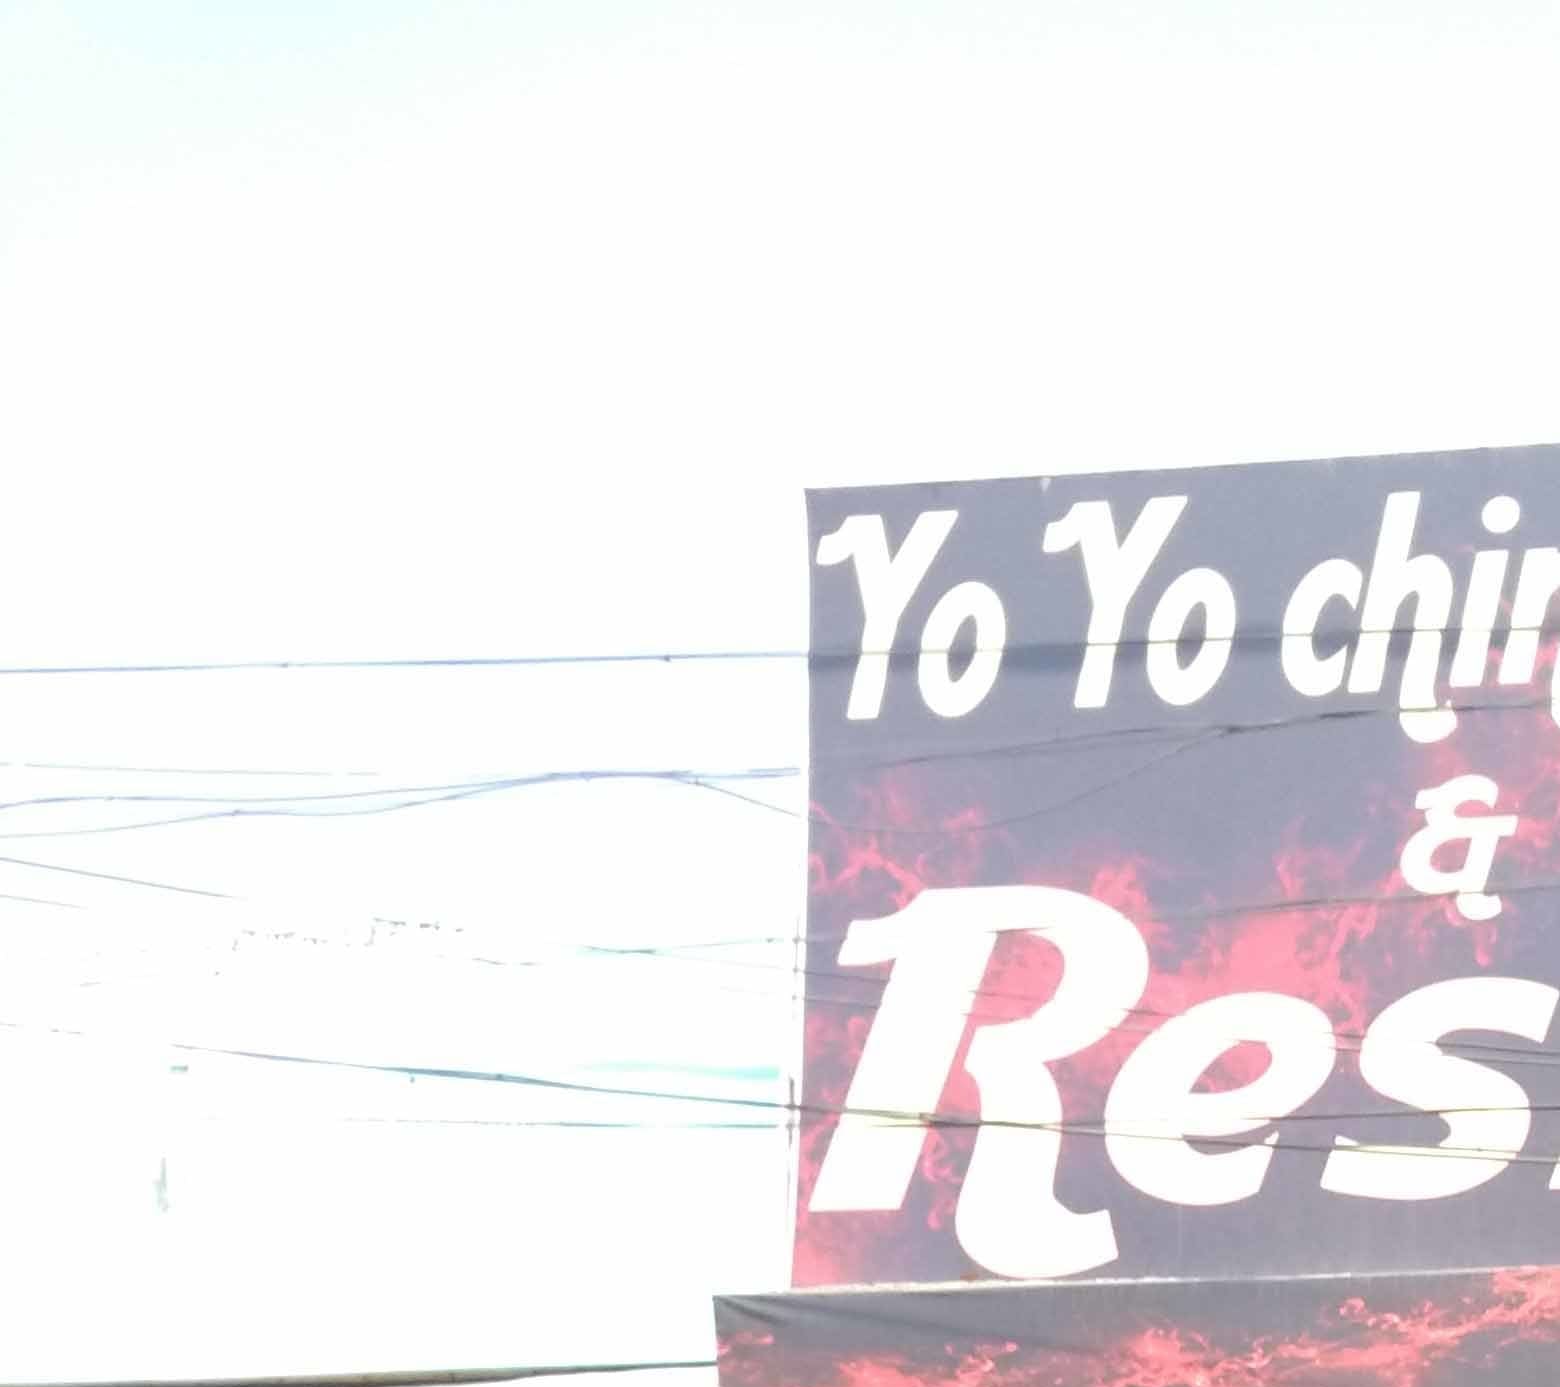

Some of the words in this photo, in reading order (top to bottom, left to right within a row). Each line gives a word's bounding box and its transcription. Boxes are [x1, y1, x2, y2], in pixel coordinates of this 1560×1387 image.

[815, 509, 1006, 720] Yo
[1041, 496, 1235, 710] Yo
[1400, 774, 1519, 921] &
